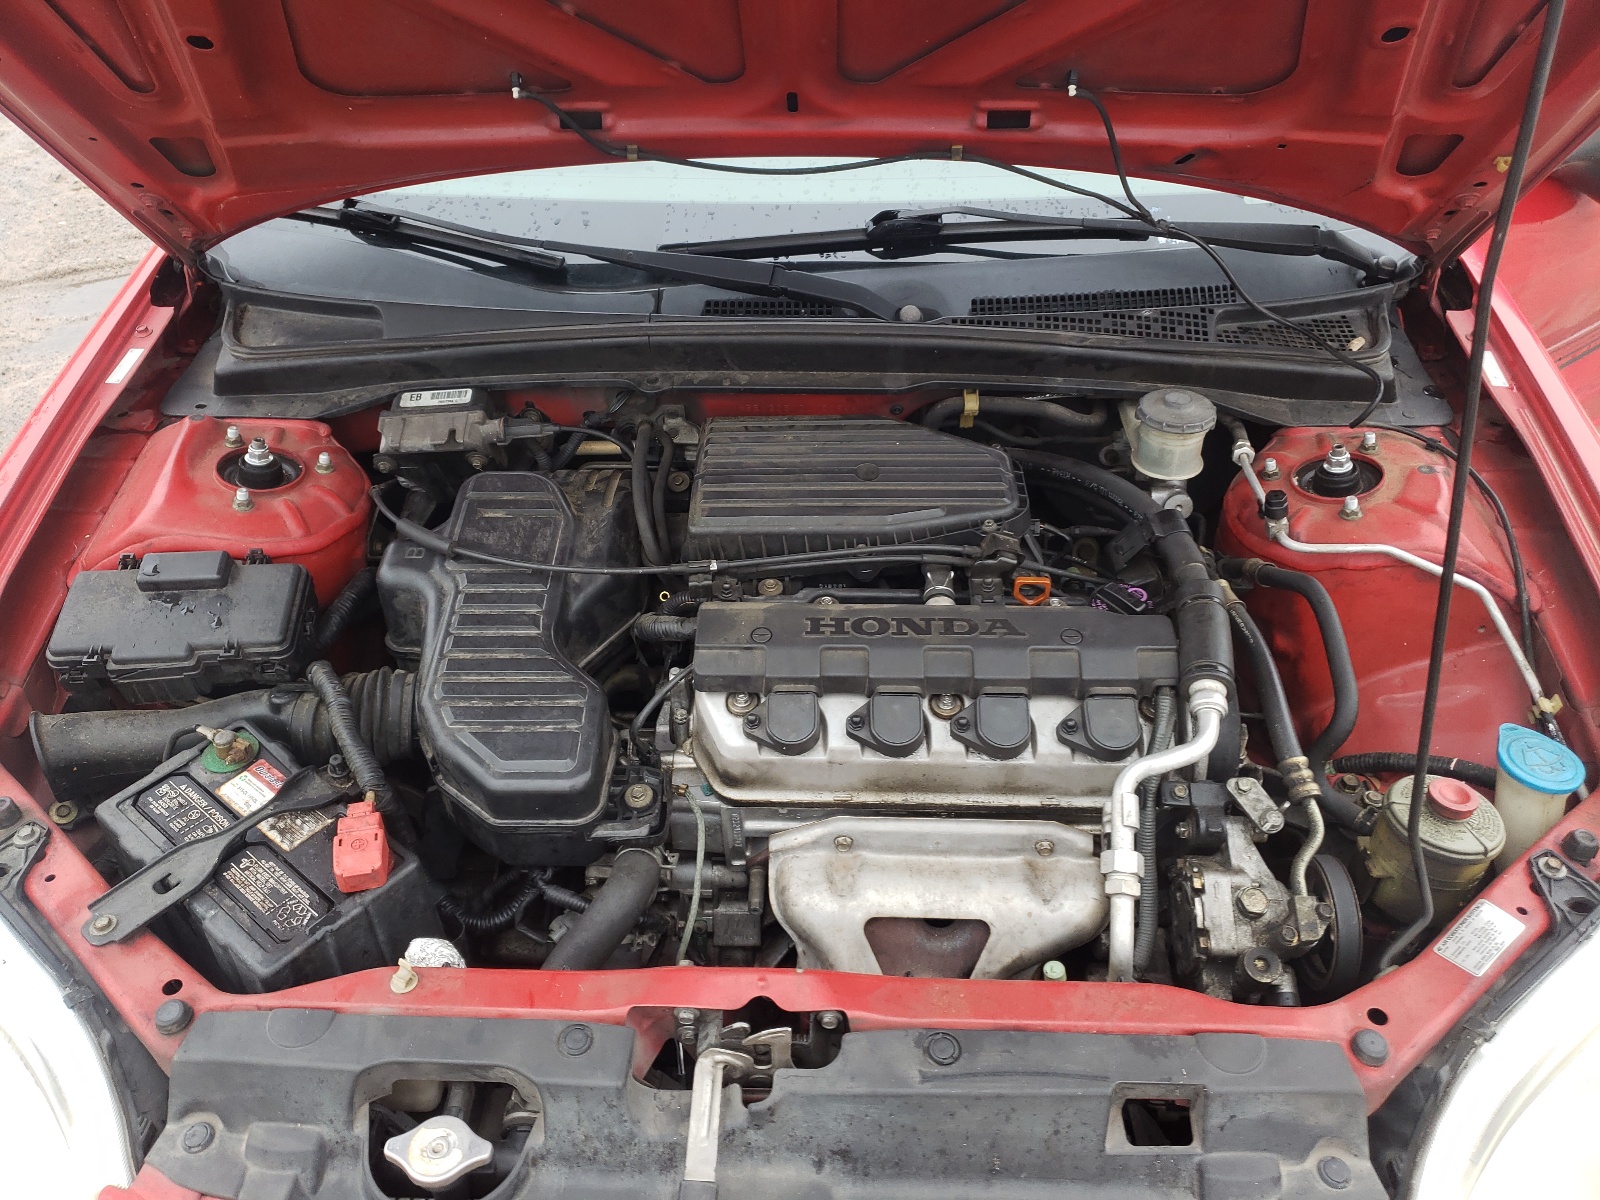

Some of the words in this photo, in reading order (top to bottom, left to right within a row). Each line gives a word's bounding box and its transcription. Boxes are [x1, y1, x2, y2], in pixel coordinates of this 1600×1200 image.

[410, 393, 422, 402] EB
[804, 616, 1027, 637] HONDA
[184, 787, 208, 808] DANGER
[208, 808, 231, 828] POISON
